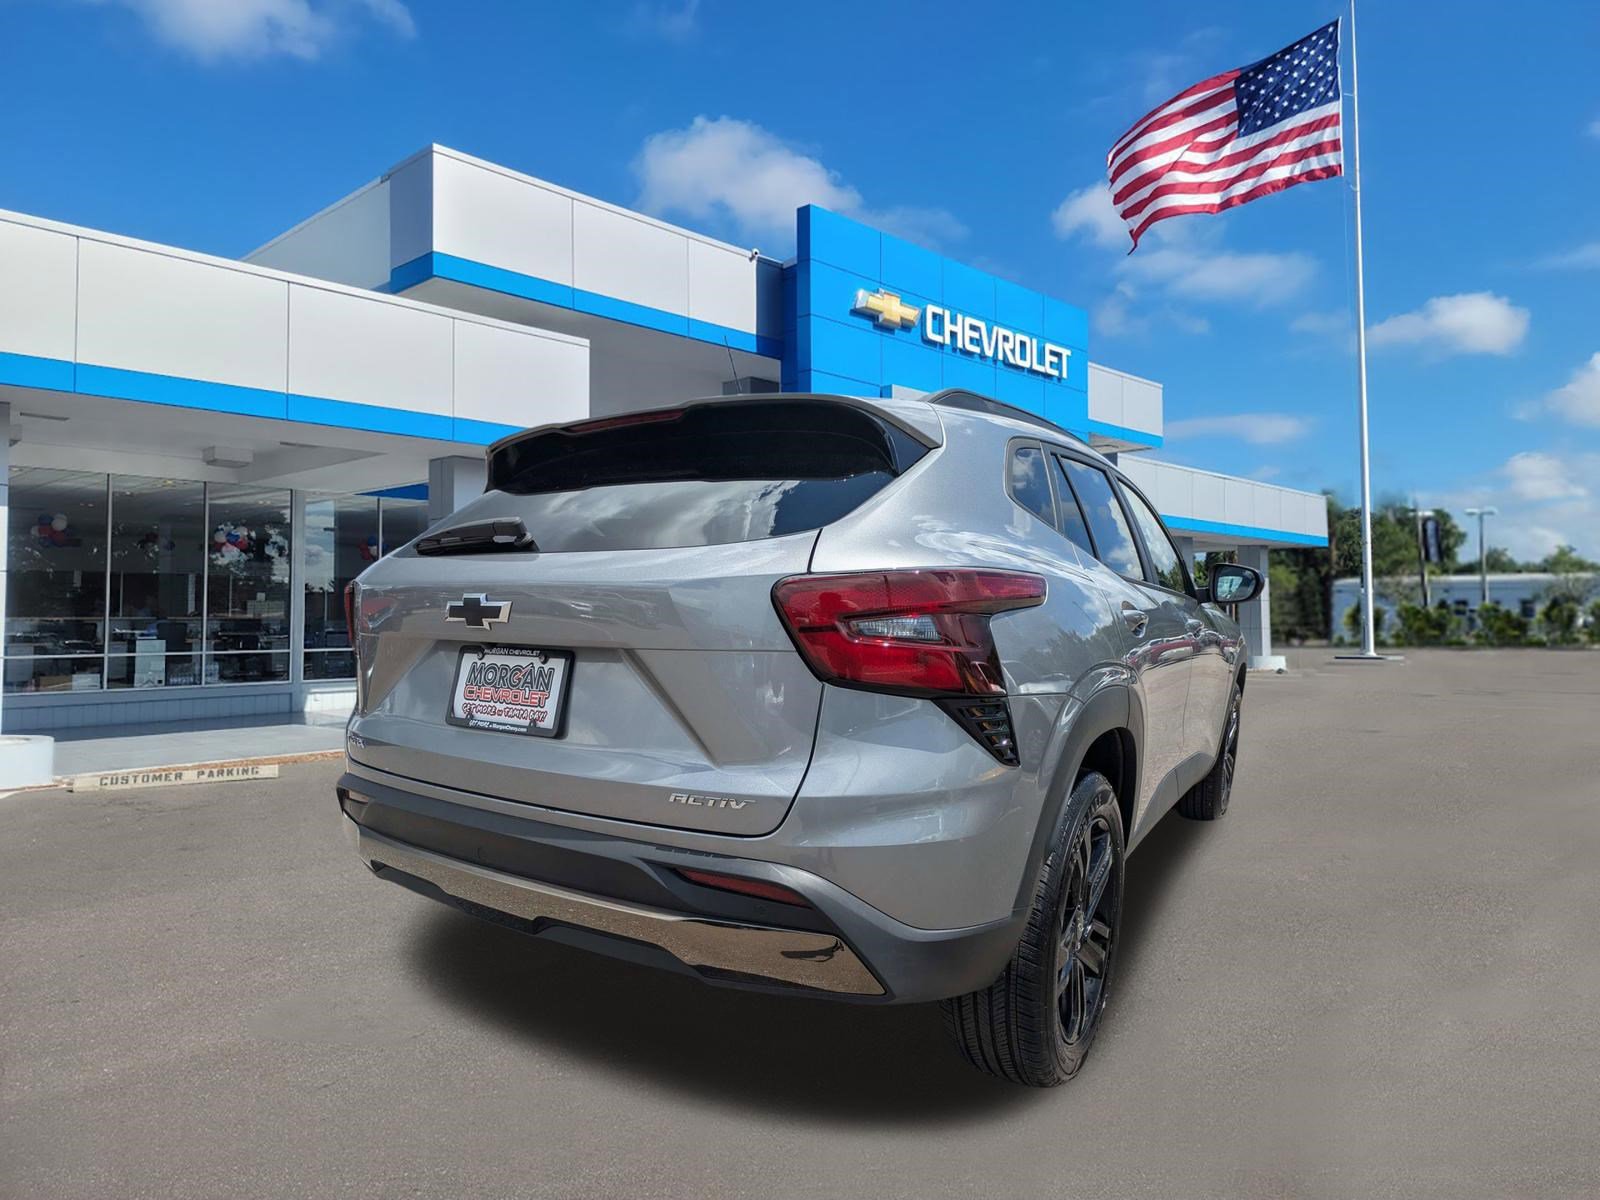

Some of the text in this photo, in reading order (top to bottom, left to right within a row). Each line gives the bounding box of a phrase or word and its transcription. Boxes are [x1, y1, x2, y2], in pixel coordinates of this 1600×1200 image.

[925, 304, 1072, 380] CHEVROLET
[484, 648, 508, 656] MORGAN
[465, 662, 555, 692] MORGAN
[464, 685, 549, 708] CHEVROLET
[476, 704, 497, 716] MORE
[504, 706, 528, 720] TAMPA
[100, 766, 260, 786] CUSTOMER PARKING
[669, 793, 756, 809] ACTIV
